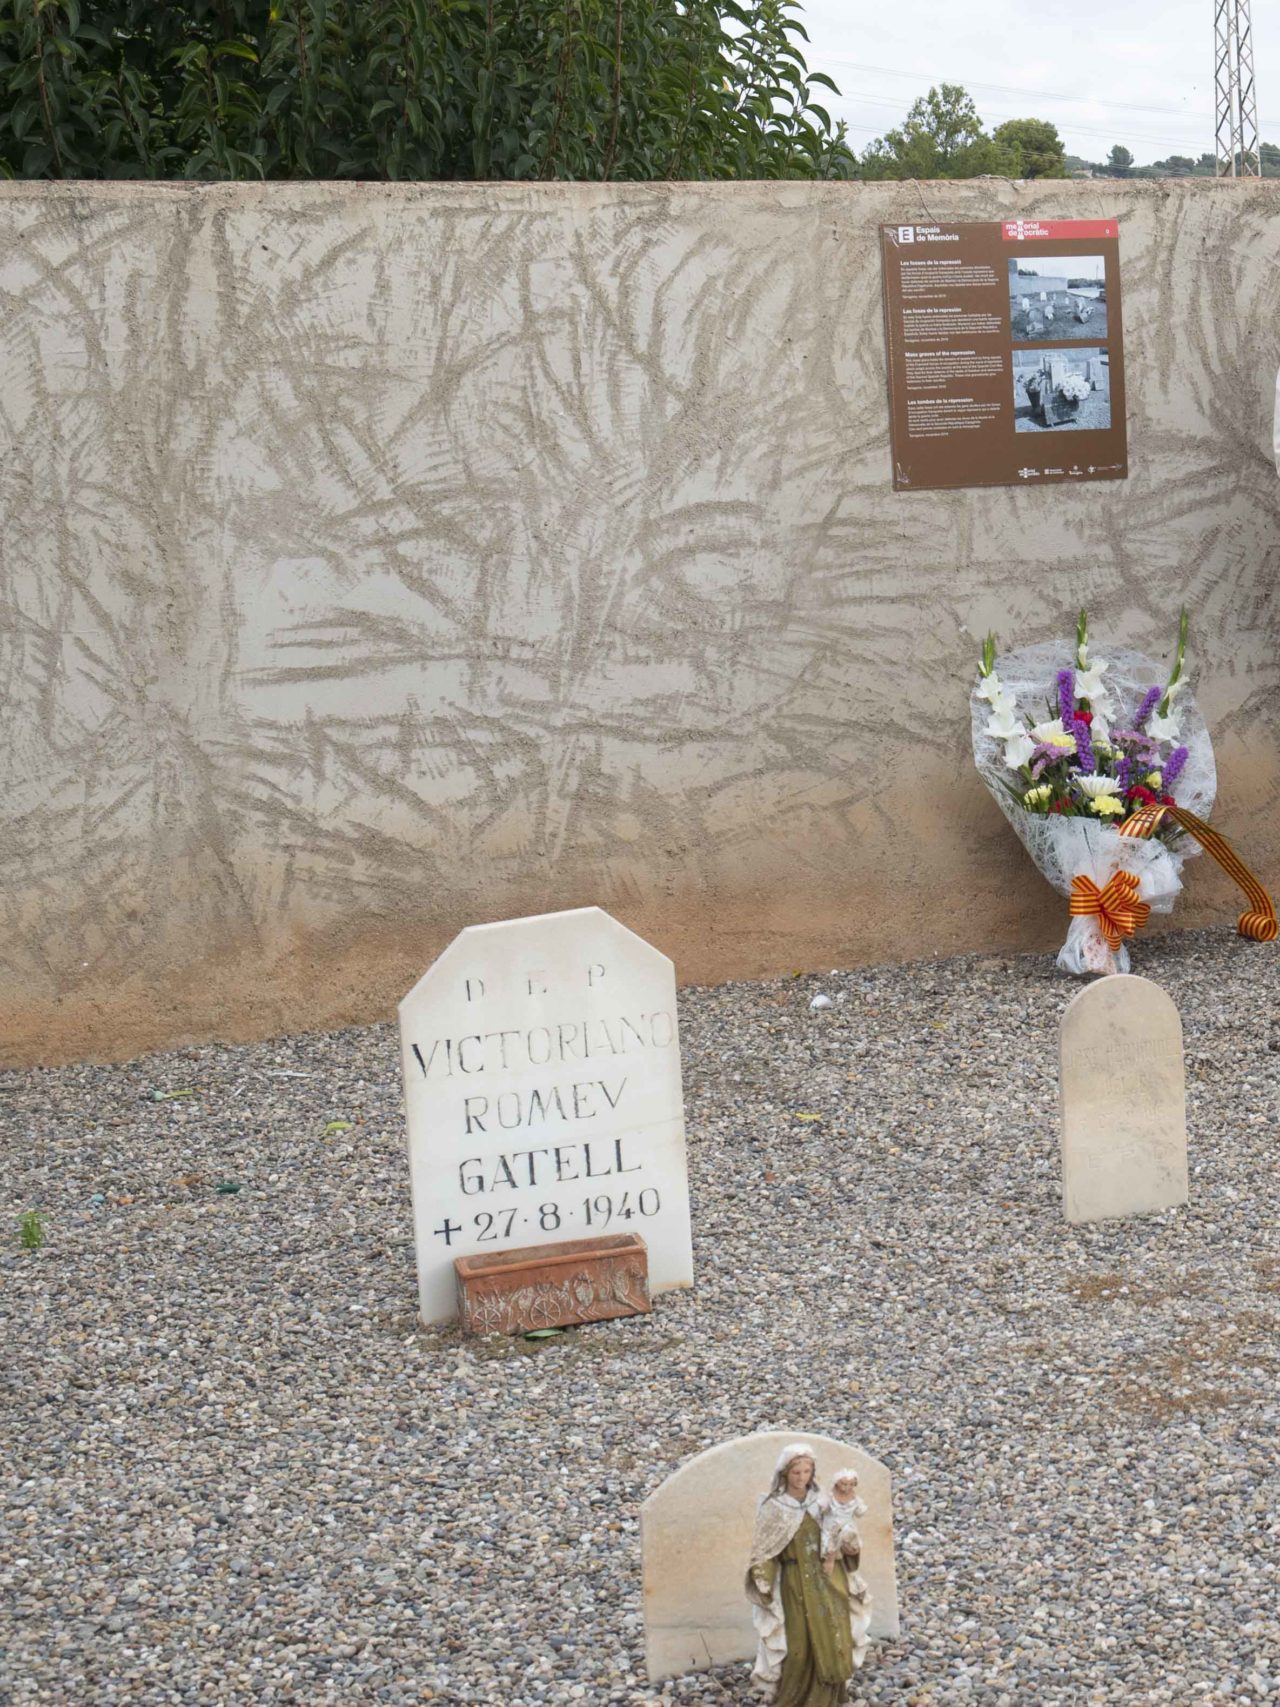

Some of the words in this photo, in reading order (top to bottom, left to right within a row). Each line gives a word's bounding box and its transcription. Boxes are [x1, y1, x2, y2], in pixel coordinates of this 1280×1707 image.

[916, 226, 940, 235] Espais
[928, 233, 960, 241] Memòria
[465, 977, 485, 1002] D
[527, 970, 547, 996] E
[587, 963, 606, 987] P
[410, 1010, 674, 1078] VICTORIANO
[459, 1138, 642, 1196] GATELL
